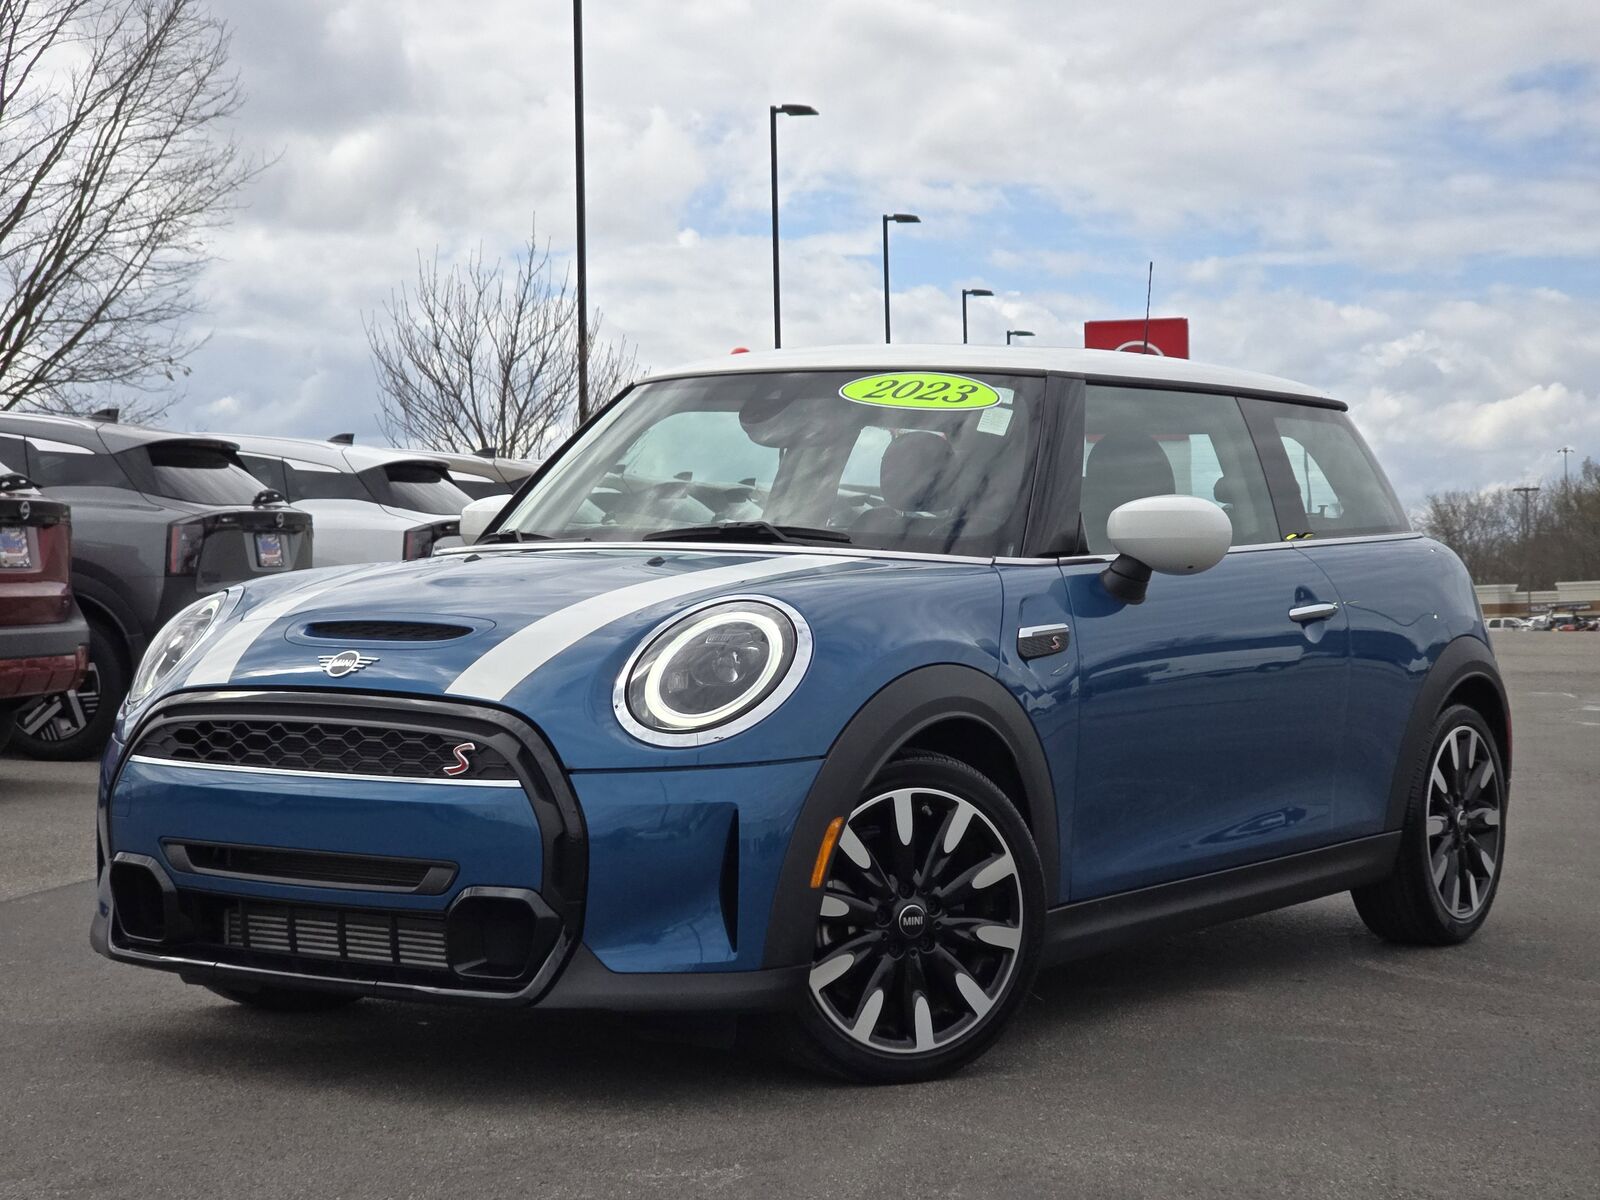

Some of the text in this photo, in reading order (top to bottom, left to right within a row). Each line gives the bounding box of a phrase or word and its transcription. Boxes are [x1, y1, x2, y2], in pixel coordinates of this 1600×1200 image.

[861, 379, 979, 403] 2023
[1050, 635, 1061, 650] S
[331, 658, 355, 667] MINI
[442, 742, 476, 776] S
[903, 916, 923, 926] MINI
